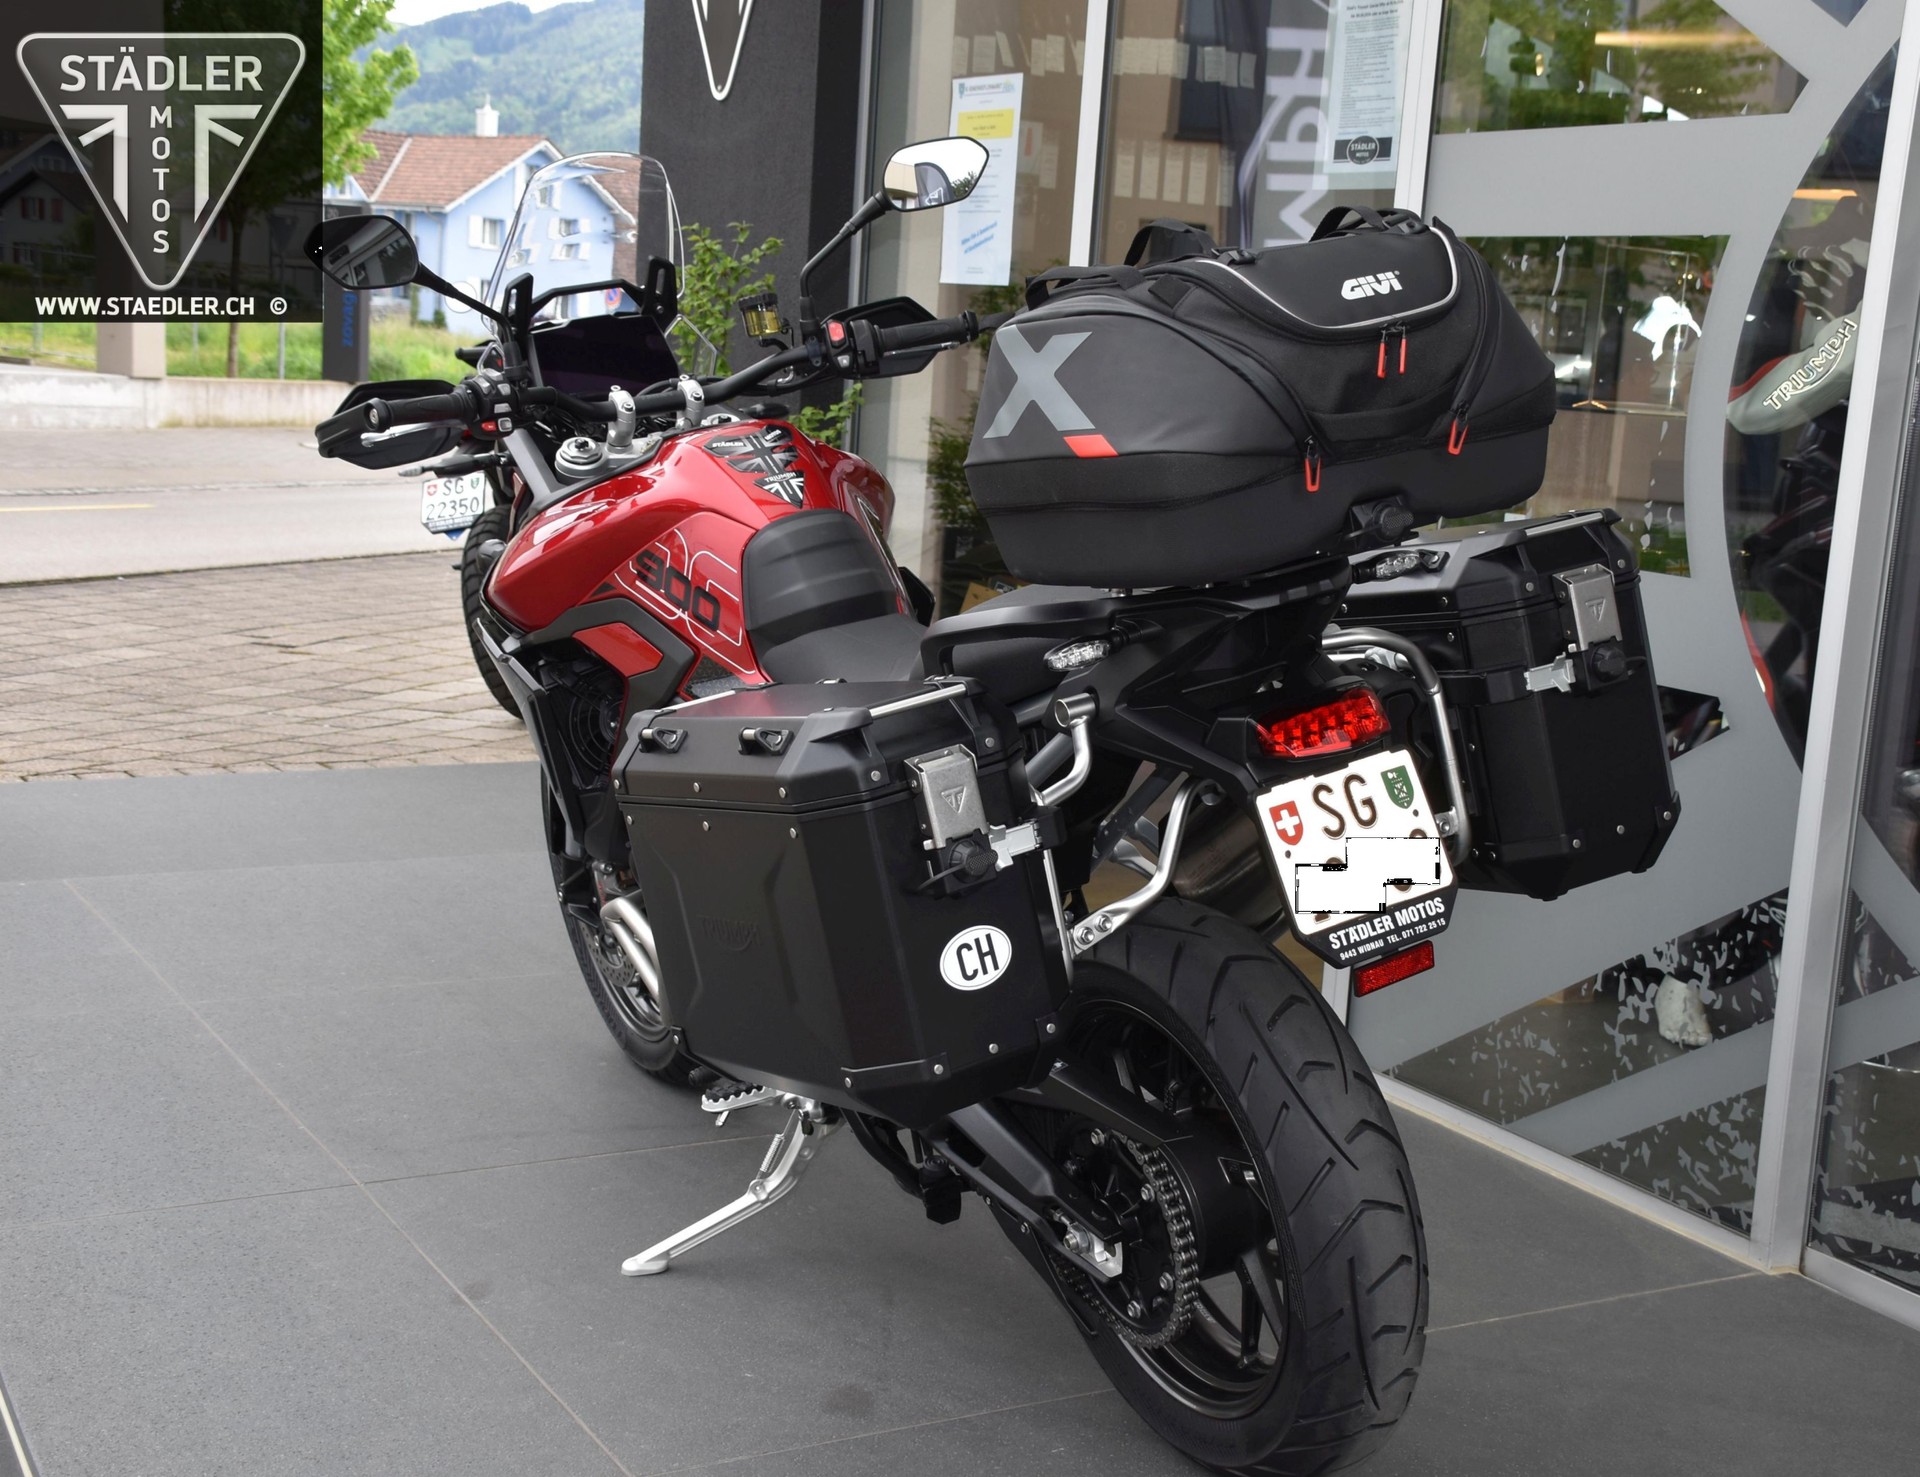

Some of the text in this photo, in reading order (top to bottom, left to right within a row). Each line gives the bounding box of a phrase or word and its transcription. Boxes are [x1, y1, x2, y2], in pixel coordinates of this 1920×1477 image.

[1350, 141, 1376, 151] STÄDLER
[1763, 318, 1858, 410] TRIUMPH
[442, 477, 464, 496] SG
[764, 472, 797, 483] TRIUMPH
[426, 497, 480, 521] 22350
[635, 549, 721, 632] 900
[1312, 773, 1378, 840] SG
[1328, 897, 1445, 950] STÄDLER MOTOS
[1339, 918, 1446, 960] 9443 WIDNAU TEL. 071 722 25 15
[956, 933, 1000, 981] CH
